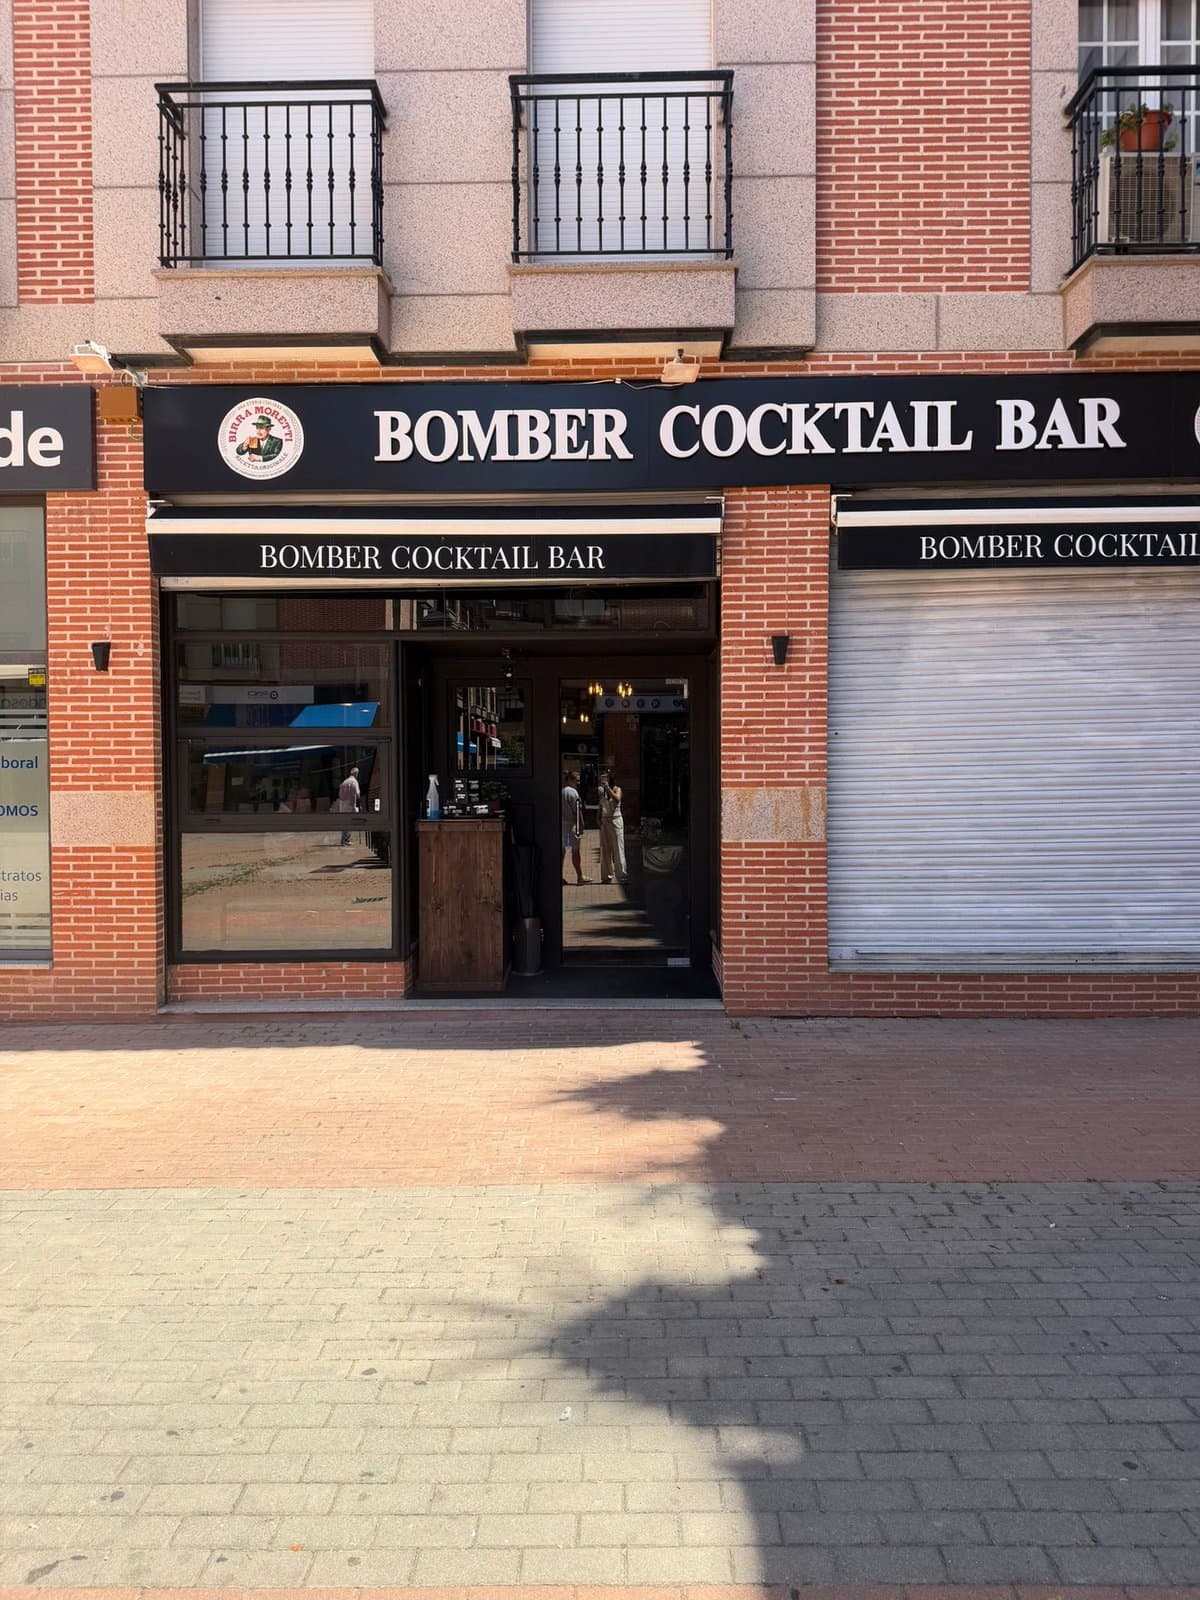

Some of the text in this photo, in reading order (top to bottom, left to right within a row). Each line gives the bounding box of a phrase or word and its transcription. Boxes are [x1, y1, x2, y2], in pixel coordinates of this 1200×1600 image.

[229, 406, 293, 442] BIRRA MORETTI
[374, 398, 1127, 462] BOMBER COCKTAIL BAR
[0, 410, 64, 468] de
[261, 544, 606, 570] BOMBER COCKTAIL BAR
[920, 533, 1200, 560] BOMBER COCKTAIL
[1, 755, 38, 769] boral
[1, 870, 42, 882] tratos
[0, 889, 18, 901] ias
